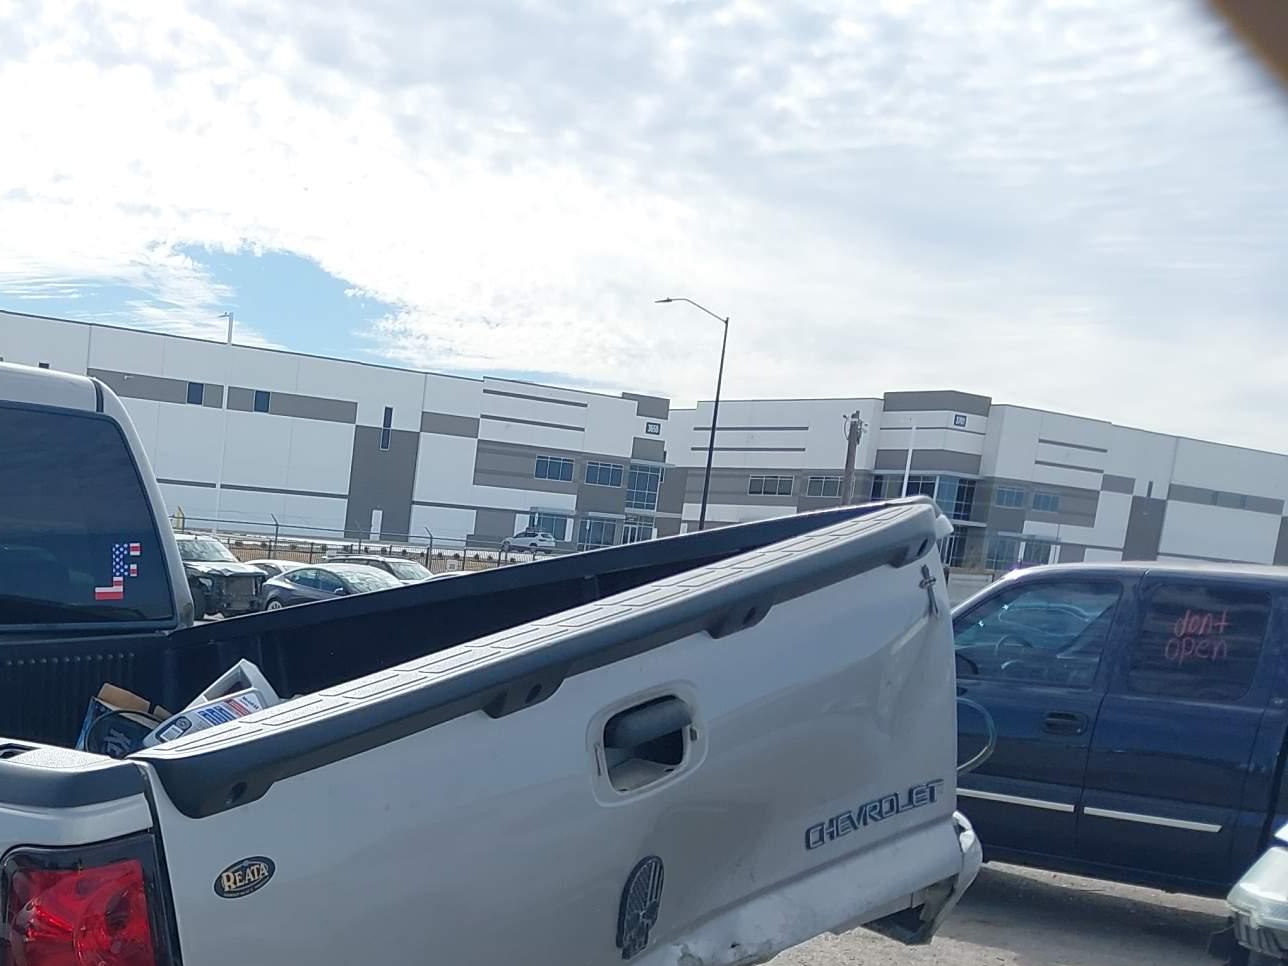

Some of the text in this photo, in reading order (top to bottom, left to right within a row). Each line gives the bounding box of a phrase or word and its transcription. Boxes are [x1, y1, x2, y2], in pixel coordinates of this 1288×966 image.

[1165, 637, 1227, 666] open
[805, 779, 944, 850] CHEVROLET
[221, 863, 269, 892] REATA
